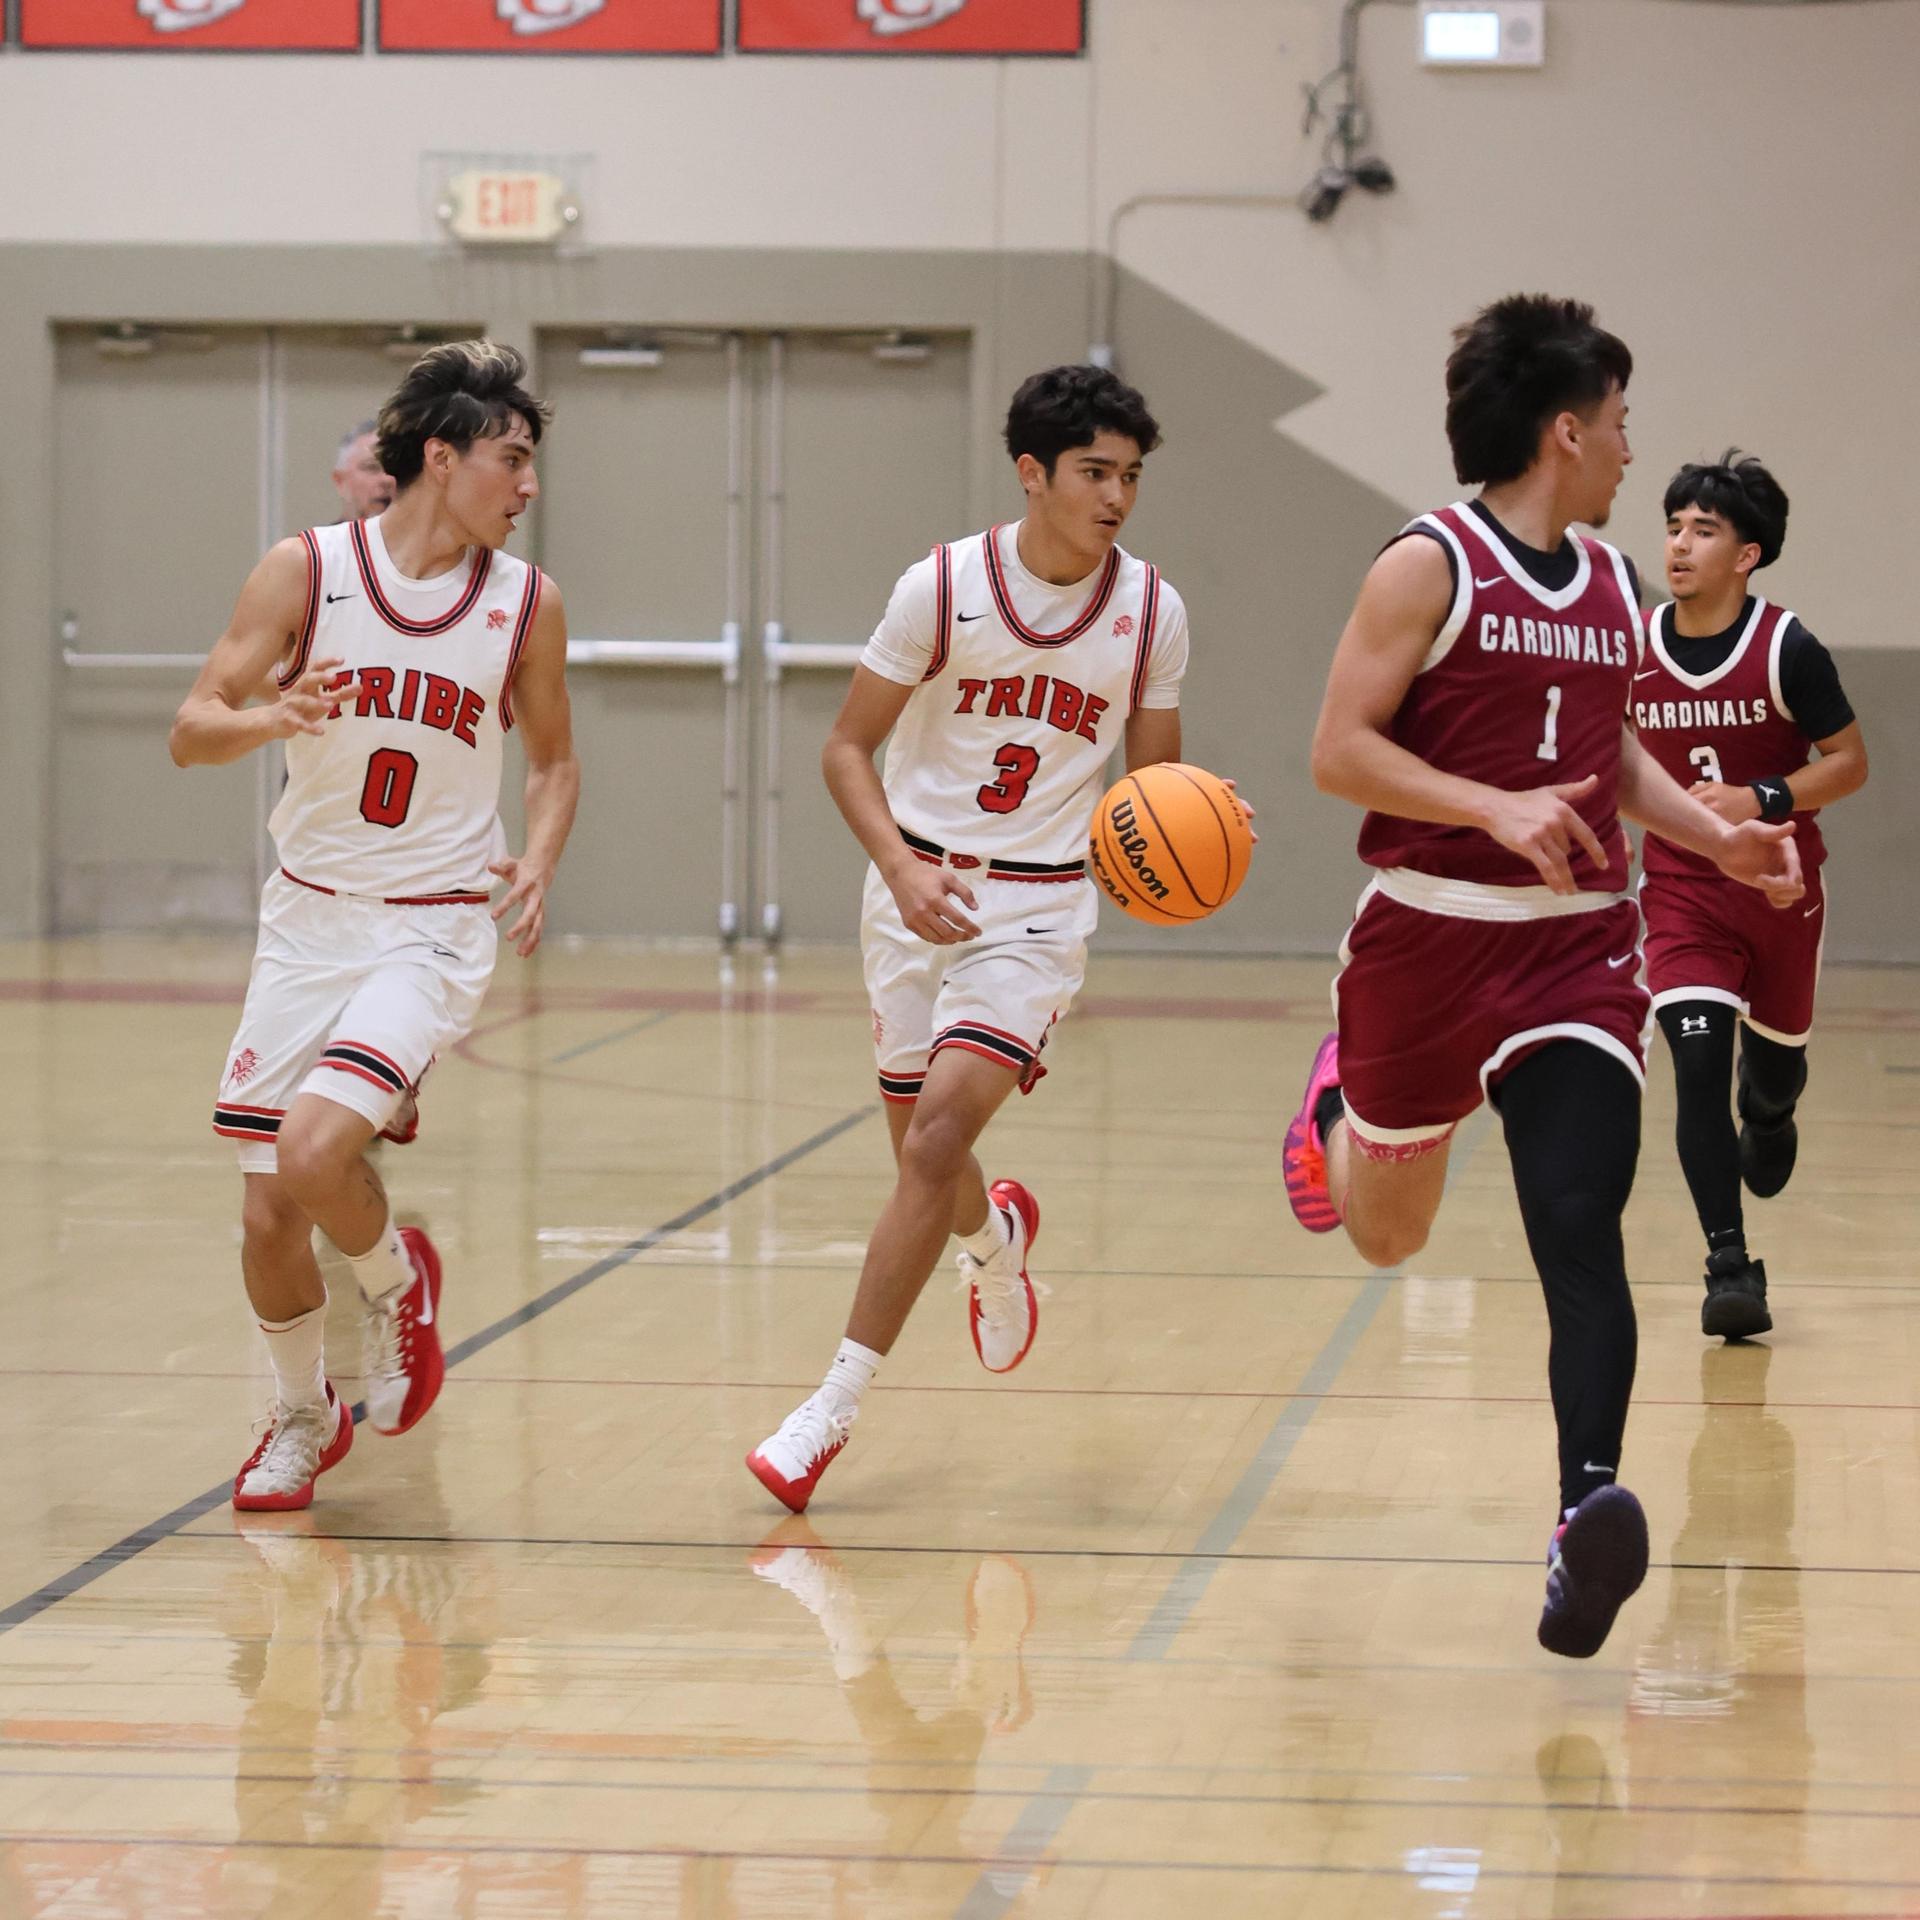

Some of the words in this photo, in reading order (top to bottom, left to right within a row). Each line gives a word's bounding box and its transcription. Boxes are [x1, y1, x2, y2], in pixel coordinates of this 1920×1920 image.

[479, 177, 537, 226] EXIT
[1479, 613, 1627, 666] CARDINALS
[953, 674, 1109, 745] TRIBE
[1536, 685, 1562, 761] 1
[1635, 698, 1767, 729] CARDINALS
[360, 747, 418, 828] 0
[976, 742, 1040, 814] 3
[1688, 745, 1724, 788] 3
[1111, 797, 1170, 901] Wilson
